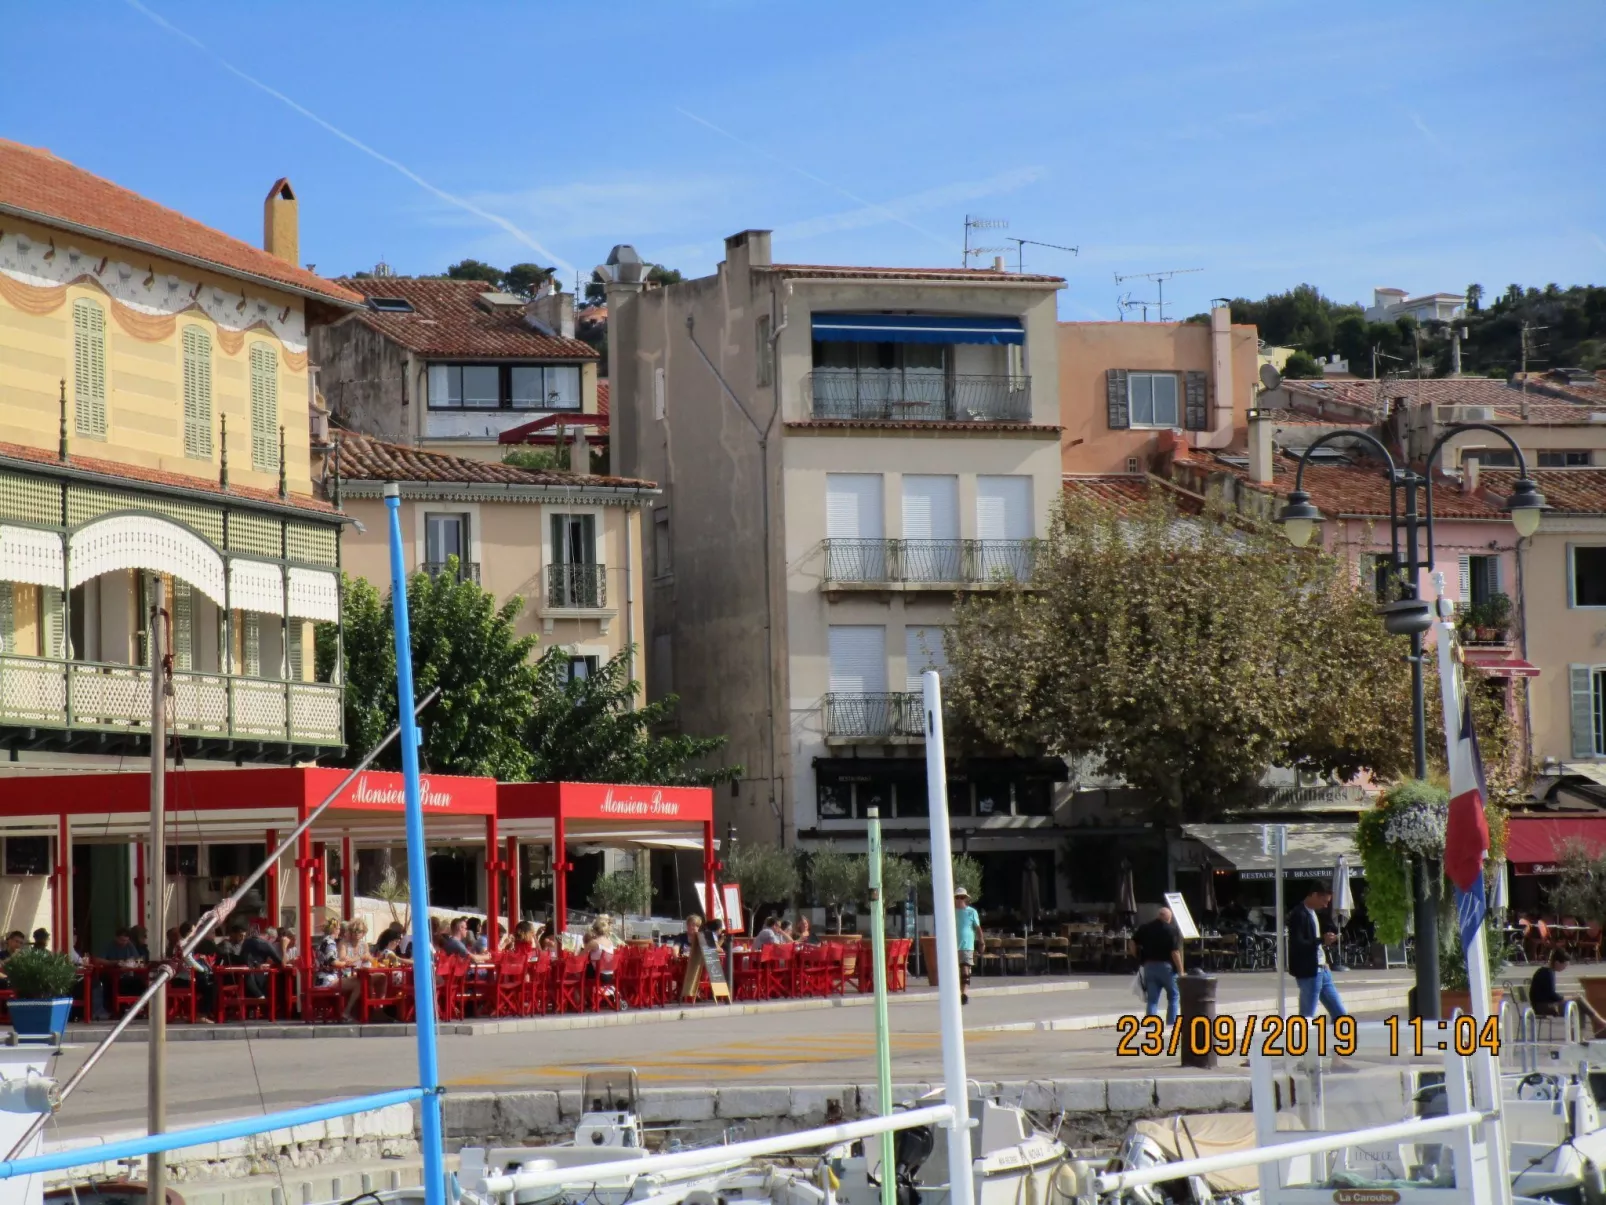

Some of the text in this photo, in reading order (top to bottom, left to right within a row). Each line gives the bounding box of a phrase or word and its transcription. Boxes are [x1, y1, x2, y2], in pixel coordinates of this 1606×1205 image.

[351, 775, 452, 807] Monsieu Brun
[600, 788, 679, 815] Monsieur Brun
[1294, 870, 1334, 879] BRASSERIE
[1339, 1193, 1394, 1202] La Caroube
